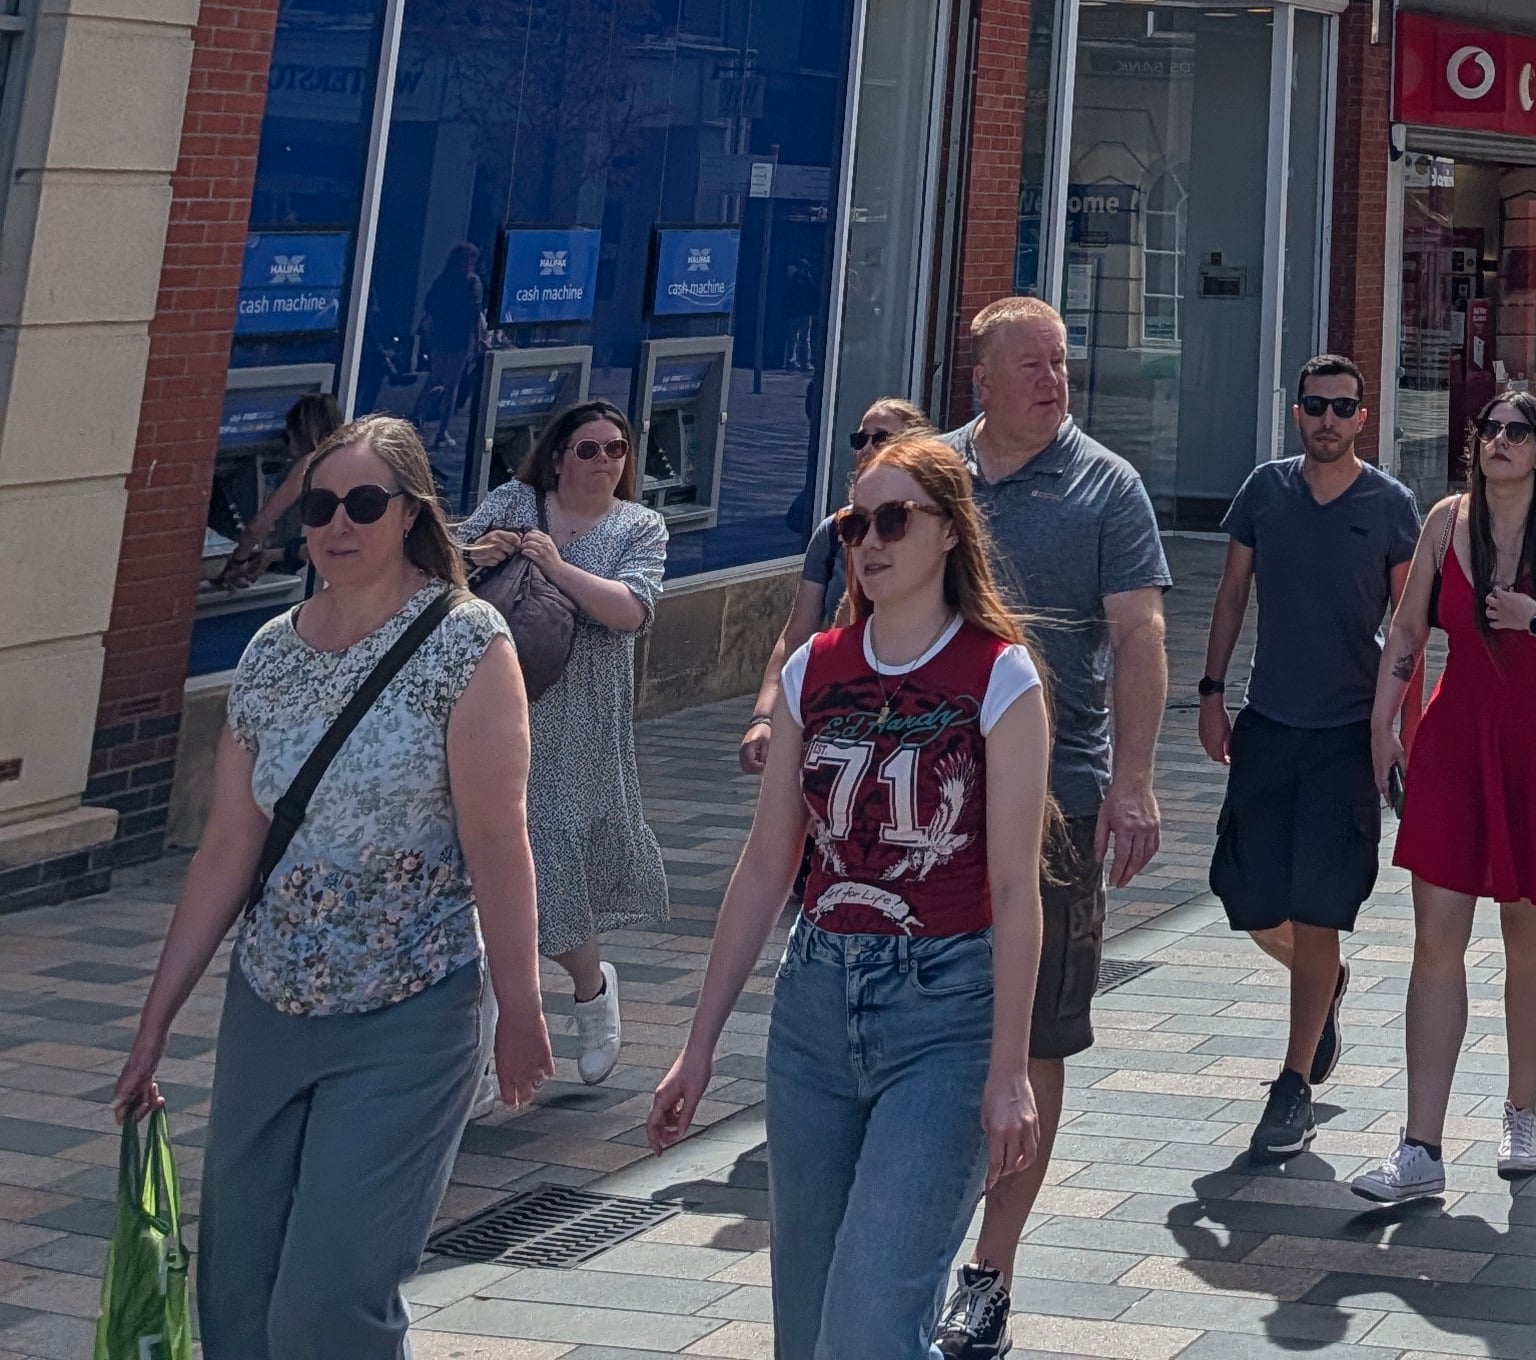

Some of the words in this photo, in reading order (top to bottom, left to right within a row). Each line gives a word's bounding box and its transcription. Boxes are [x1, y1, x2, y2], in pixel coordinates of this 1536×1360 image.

[1021, 188, 1119, 215] Weome
[270, 264, 305, 274] HALIFAX
[540, 258, 567, 268] HALIFAX
[688, 255, 711, 264] HALIFAX
[516, 286, 539, 302] cash
[541, 284, 583, 301] machine
[668, 282, 688, 296] cash
[690, 279, 725, 294] machine
[240, 295, 269, 314] cash
[272, 292, 326, 313] machine
[861, 696, 978, 747] Hardy
[803, 735, 933, 847] 71
[841, 888, 862, 902] for
[863, 889, 901, 910] Life!
